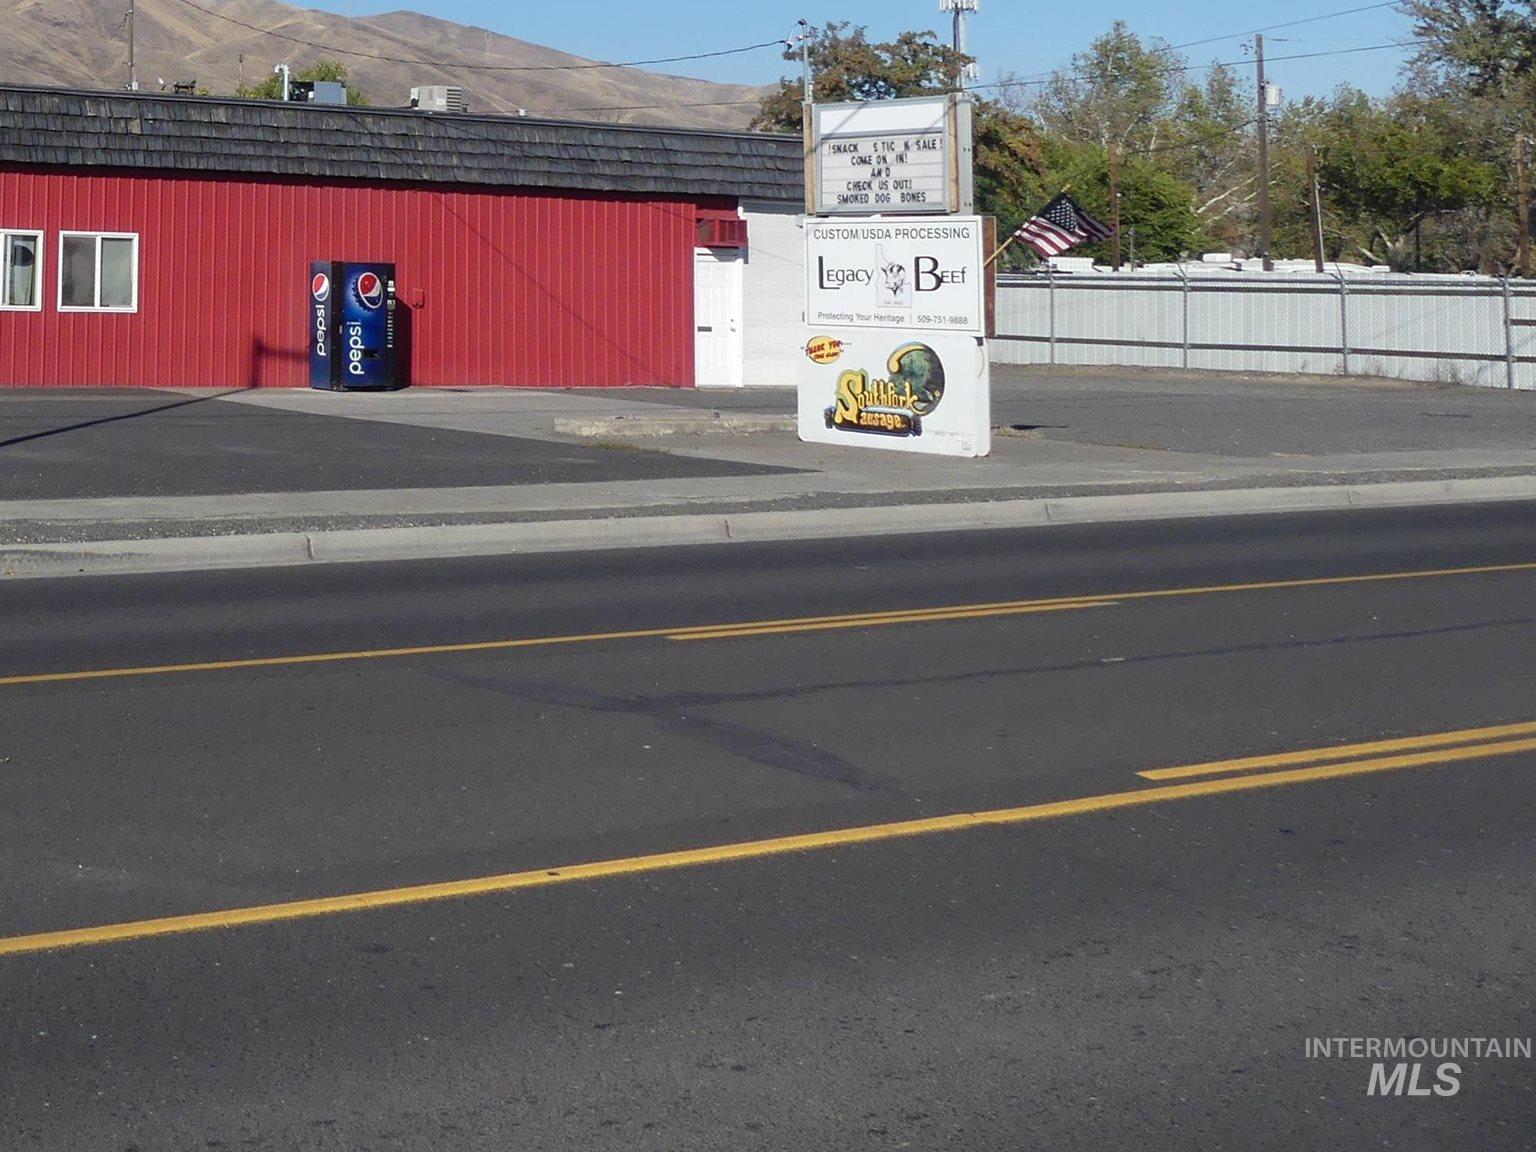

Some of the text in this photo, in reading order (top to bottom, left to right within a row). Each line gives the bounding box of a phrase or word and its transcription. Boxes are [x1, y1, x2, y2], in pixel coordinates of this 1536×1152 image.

[876, 155, 887, 165] ON
[846, 179, 913, 191] CHECK US OUT!
[837, 192, 927, 205] SMOKED DOG BONES
[814, 227, 970, 240] CUSTOM USDA PROCESSING
[817, 311, 854, 323] Protecting
[856, 313, 872, 322] Your
[873, 313, 905, 324] Heritage
[316, 304, 327, 357] pepsi
[346, 320, 365, 375] pepsi
[835, 373, 926, 424] Southfork
